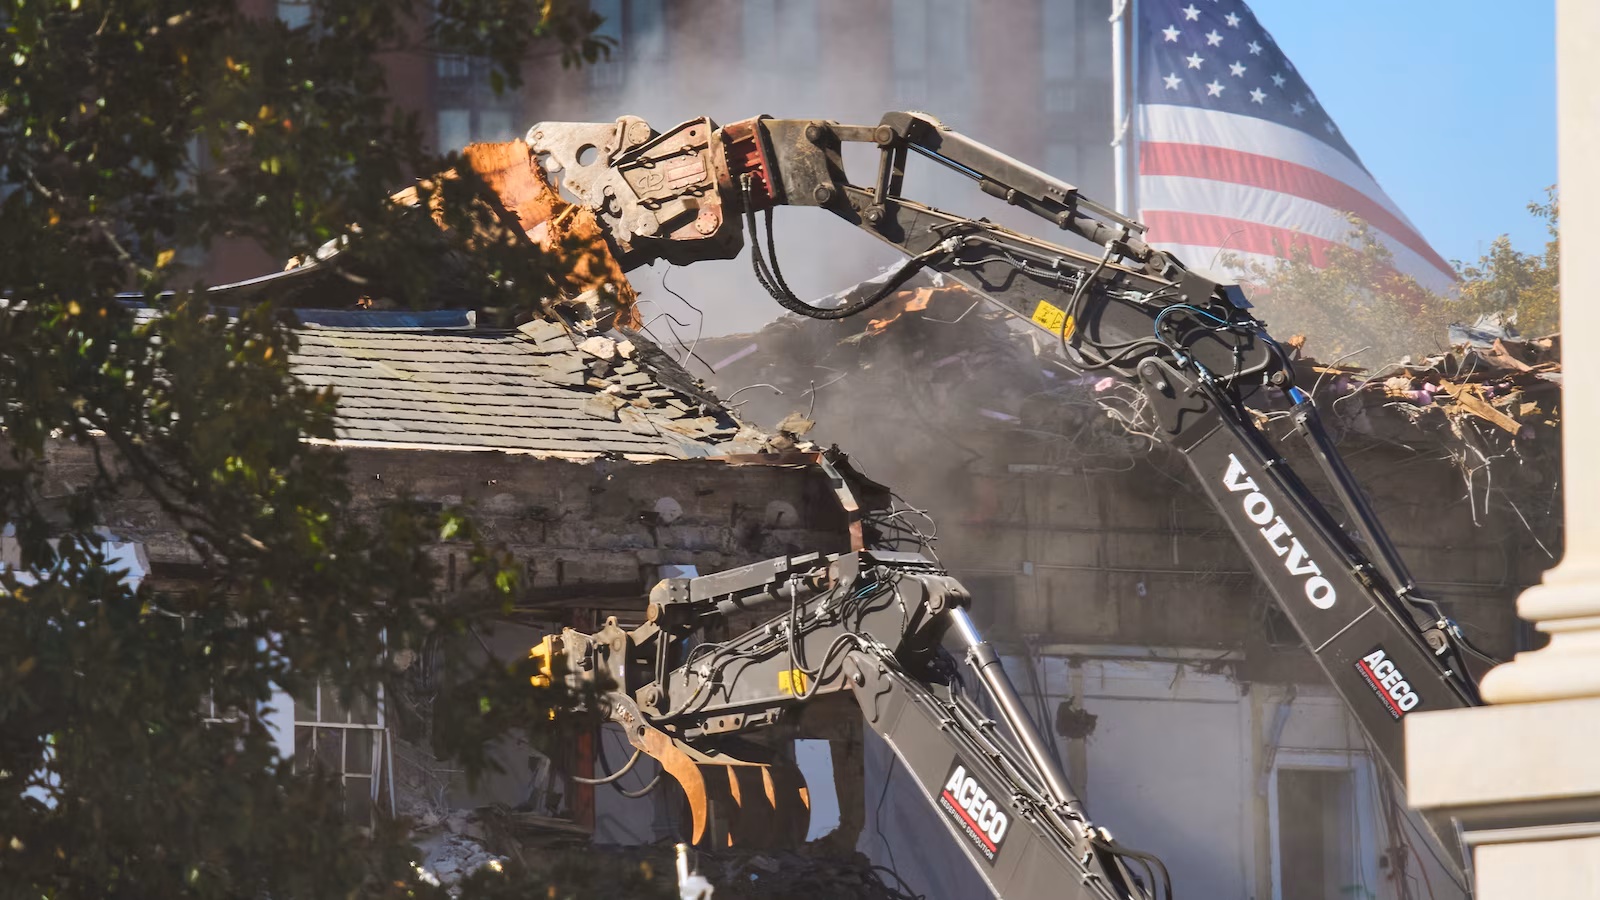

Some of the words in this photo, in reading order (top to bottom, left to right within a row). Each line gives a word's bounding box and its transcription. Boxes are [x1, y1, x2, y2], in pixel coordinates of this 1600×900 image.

[1223, 453, 1336, 609] VOLVO
[1355, 663, 1377, 691] REDEFINING
[1376, 690, 1399, 719] DEMOLITION
[1363, 650, 1419, 711] ACECO
[940, 796, 967, 829] REDEFINING
[966, 826, 994, 860] DEMOLITION
[945, 765, 1008, 843] ACECO
